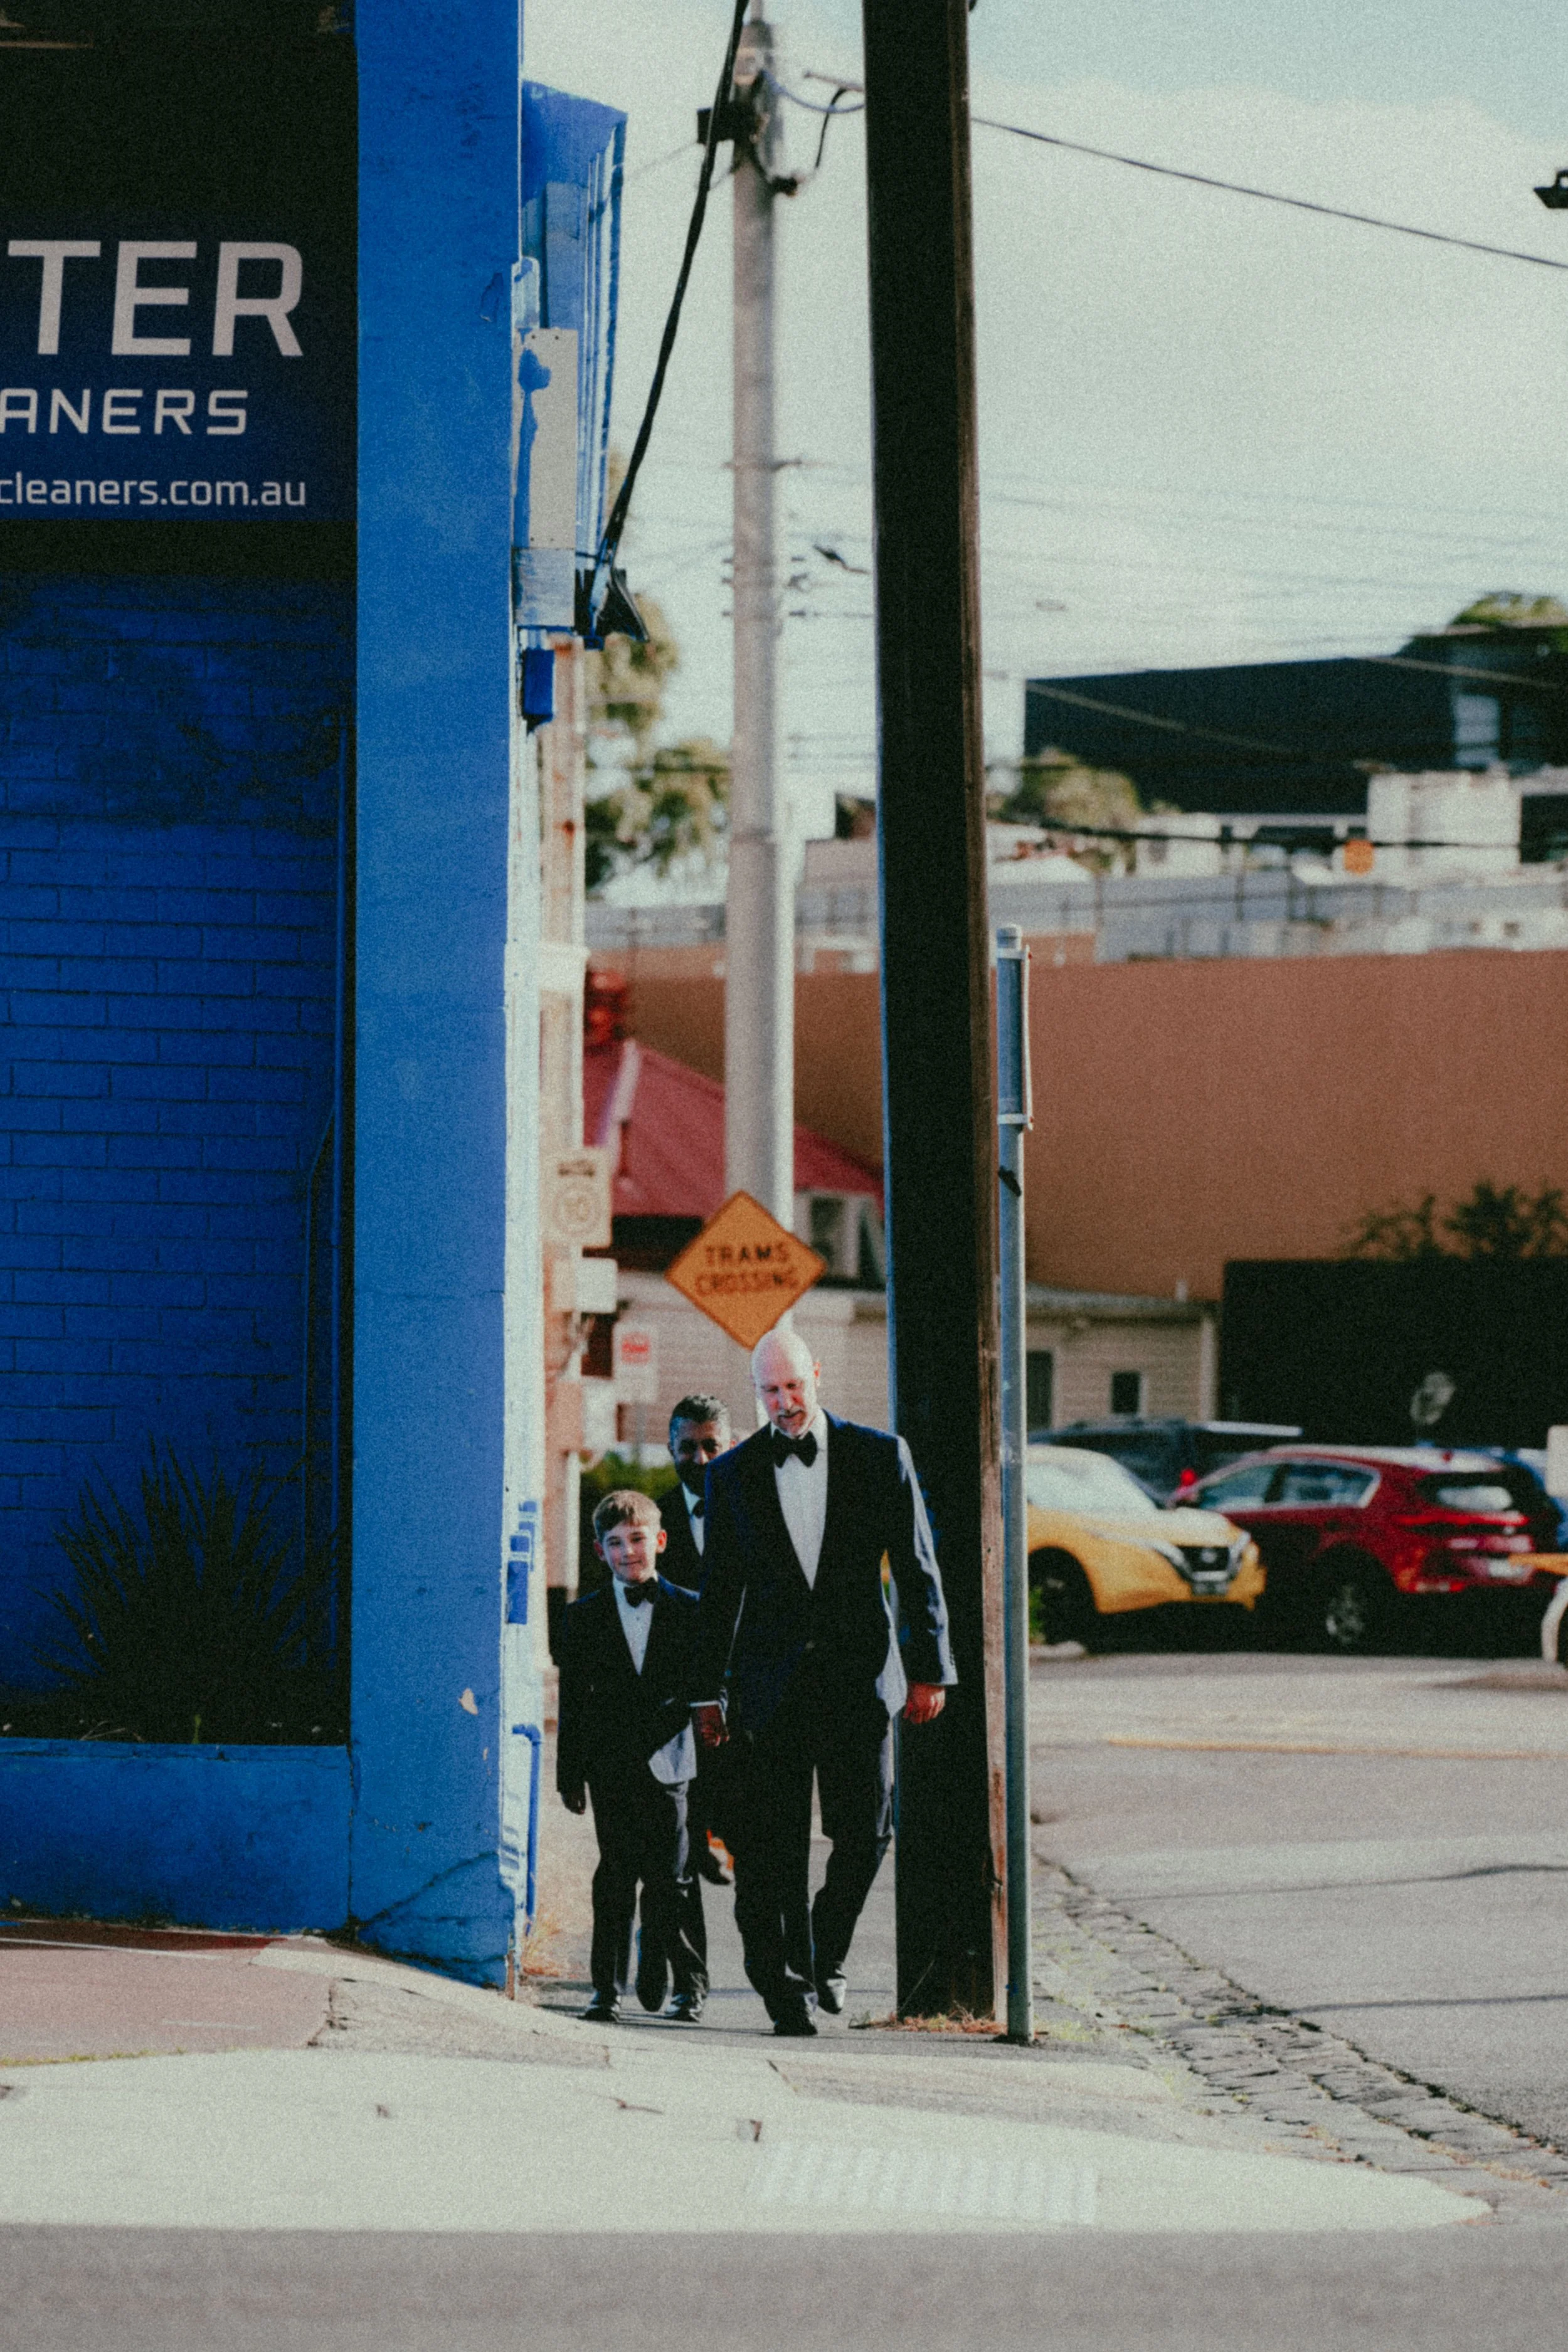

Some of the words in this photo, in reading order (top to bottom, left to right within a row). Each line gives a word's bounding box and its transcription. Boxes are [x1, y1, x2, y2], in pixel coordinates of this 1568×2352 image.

[8, 240, 304, 356] TER
[0, 388, 248, 435] ANERS
[0, 472, 305, 506] cleaners.com.au
[705, 1242, 792, 1266] TRAMS
